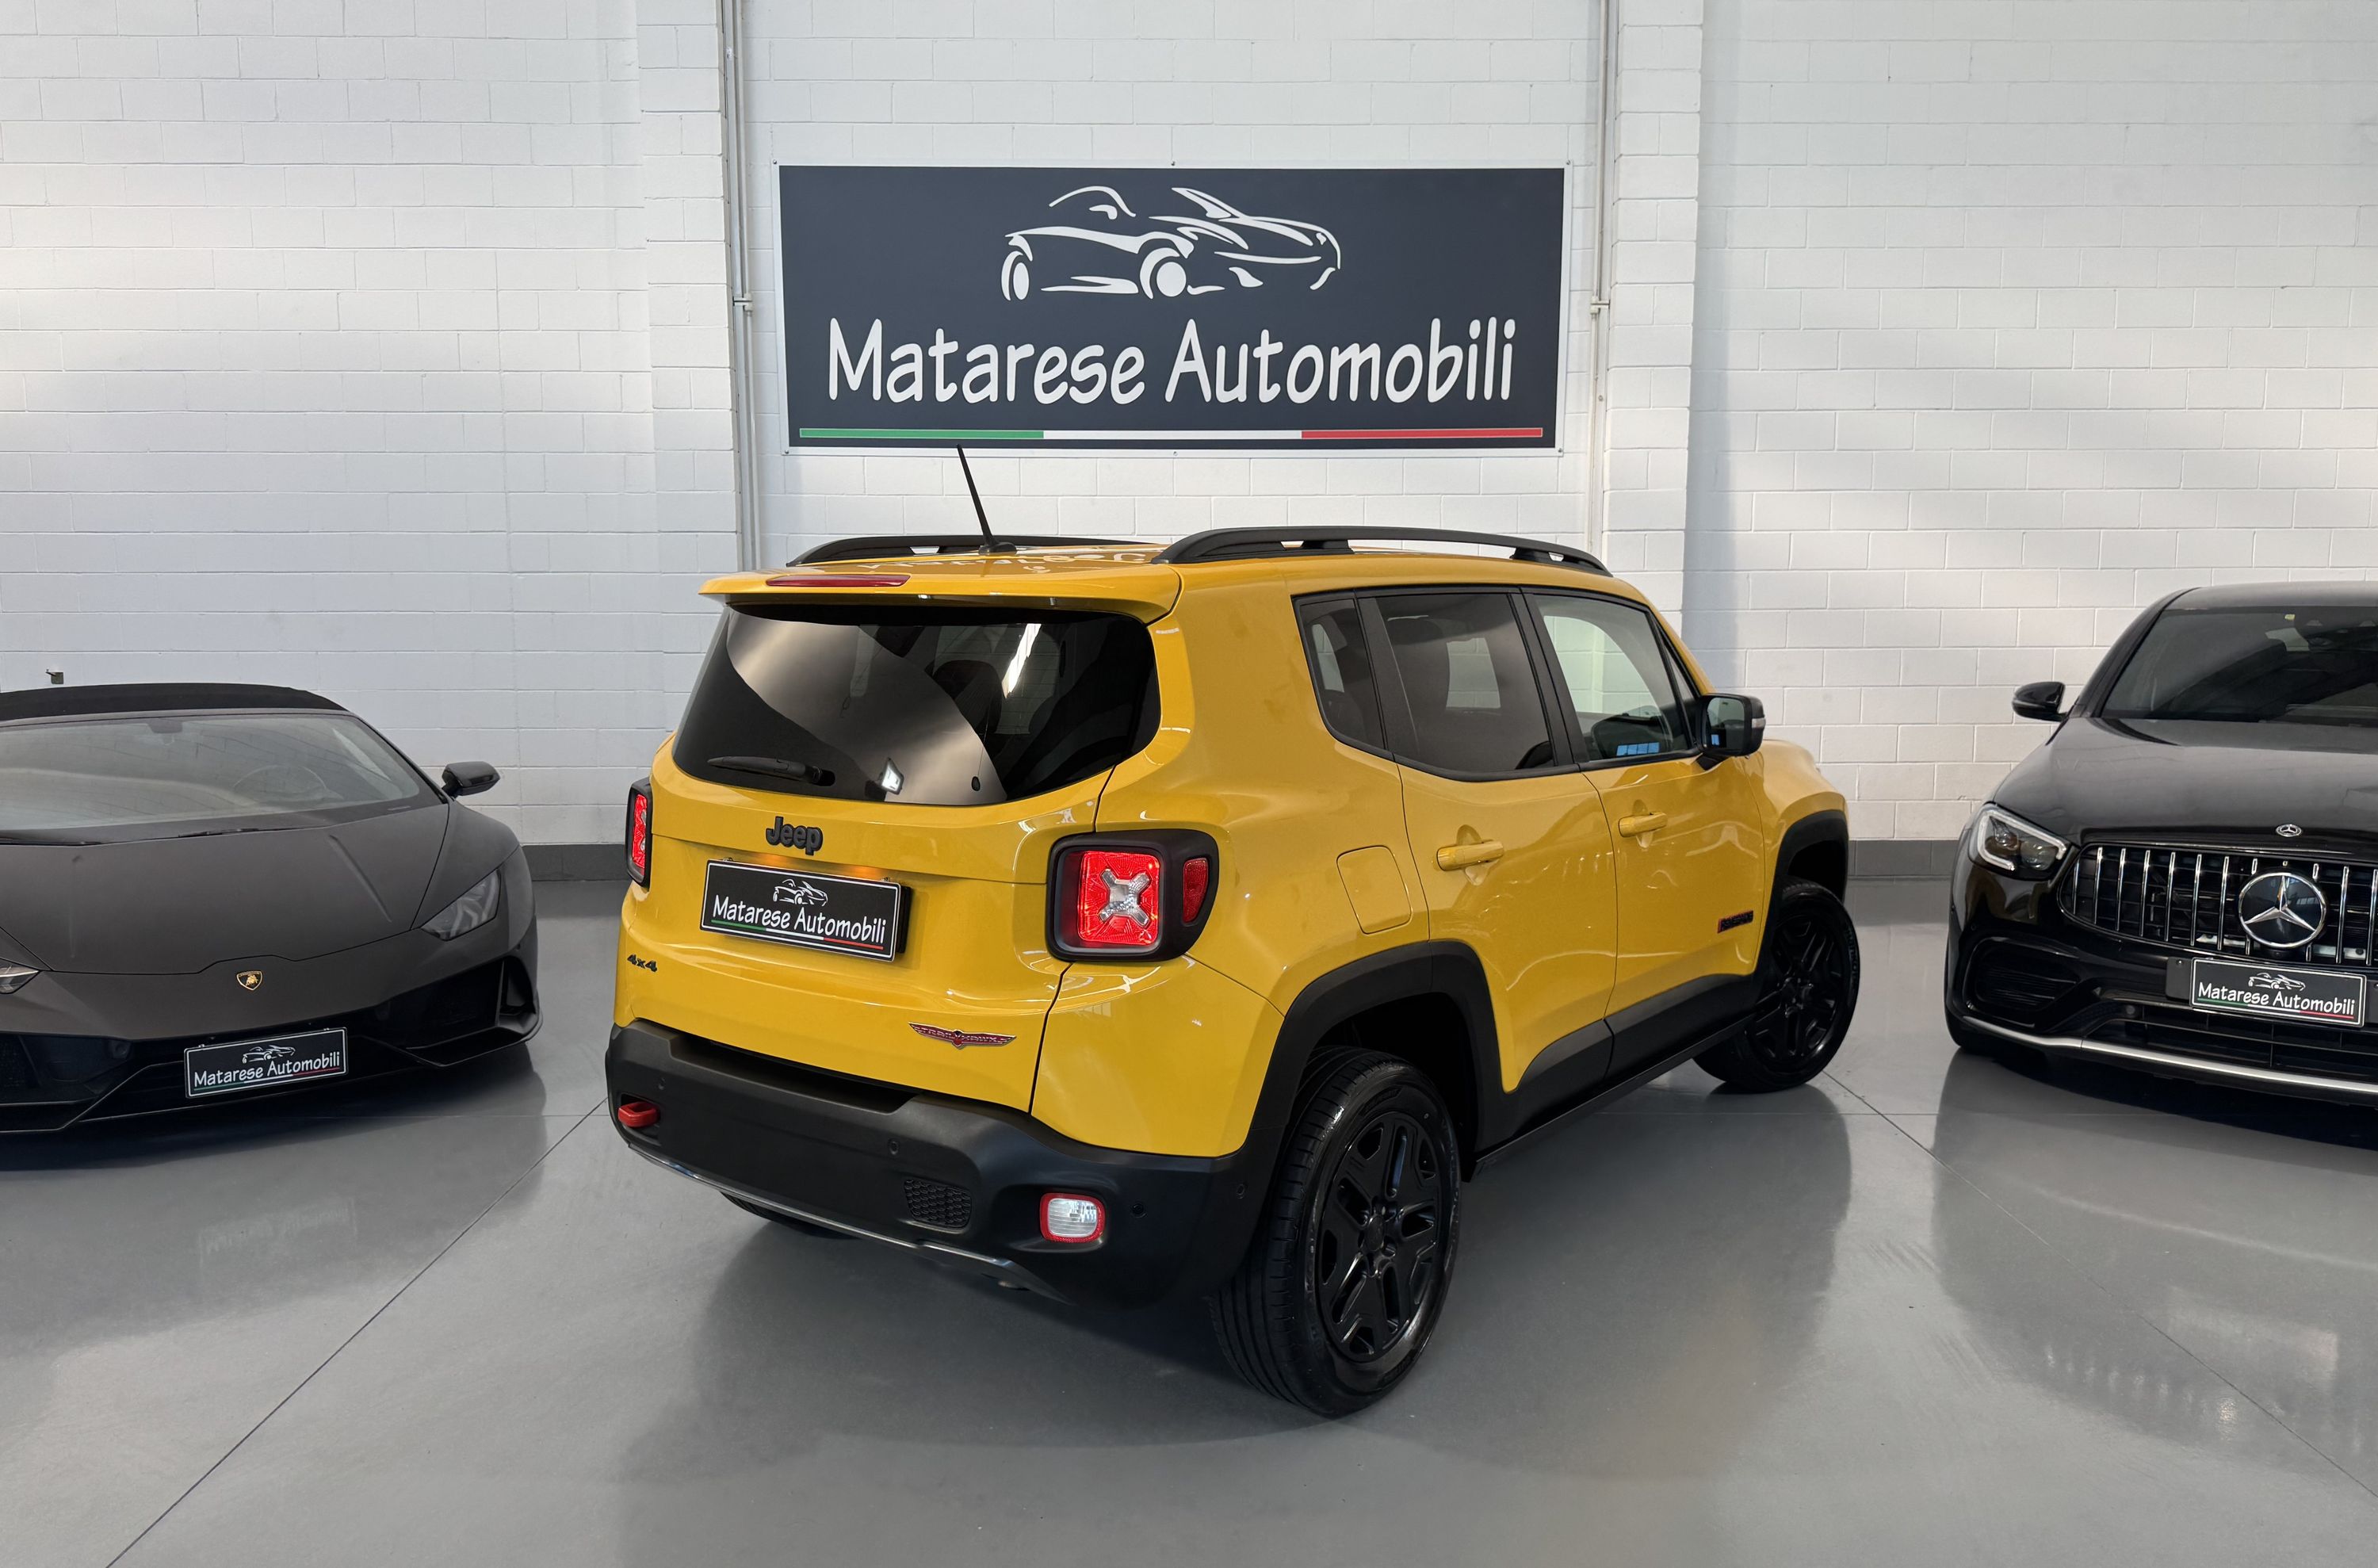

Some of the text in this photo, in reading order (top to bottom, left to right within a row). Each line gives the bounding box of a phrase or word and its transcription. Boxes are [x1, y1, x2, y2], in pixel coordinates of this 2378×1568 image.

[828, 316, 1516, 405] Matarese Automobili
[765, 816, 823, 855] Jeep
[713, 894, 886, 944] Matarese Automobili
[627, 954, 658, 973] 4x4
[2198, 981, 2356, 1015] Matarese Automobili
[193, 1051, 340, 1088] Matarese Automobili
